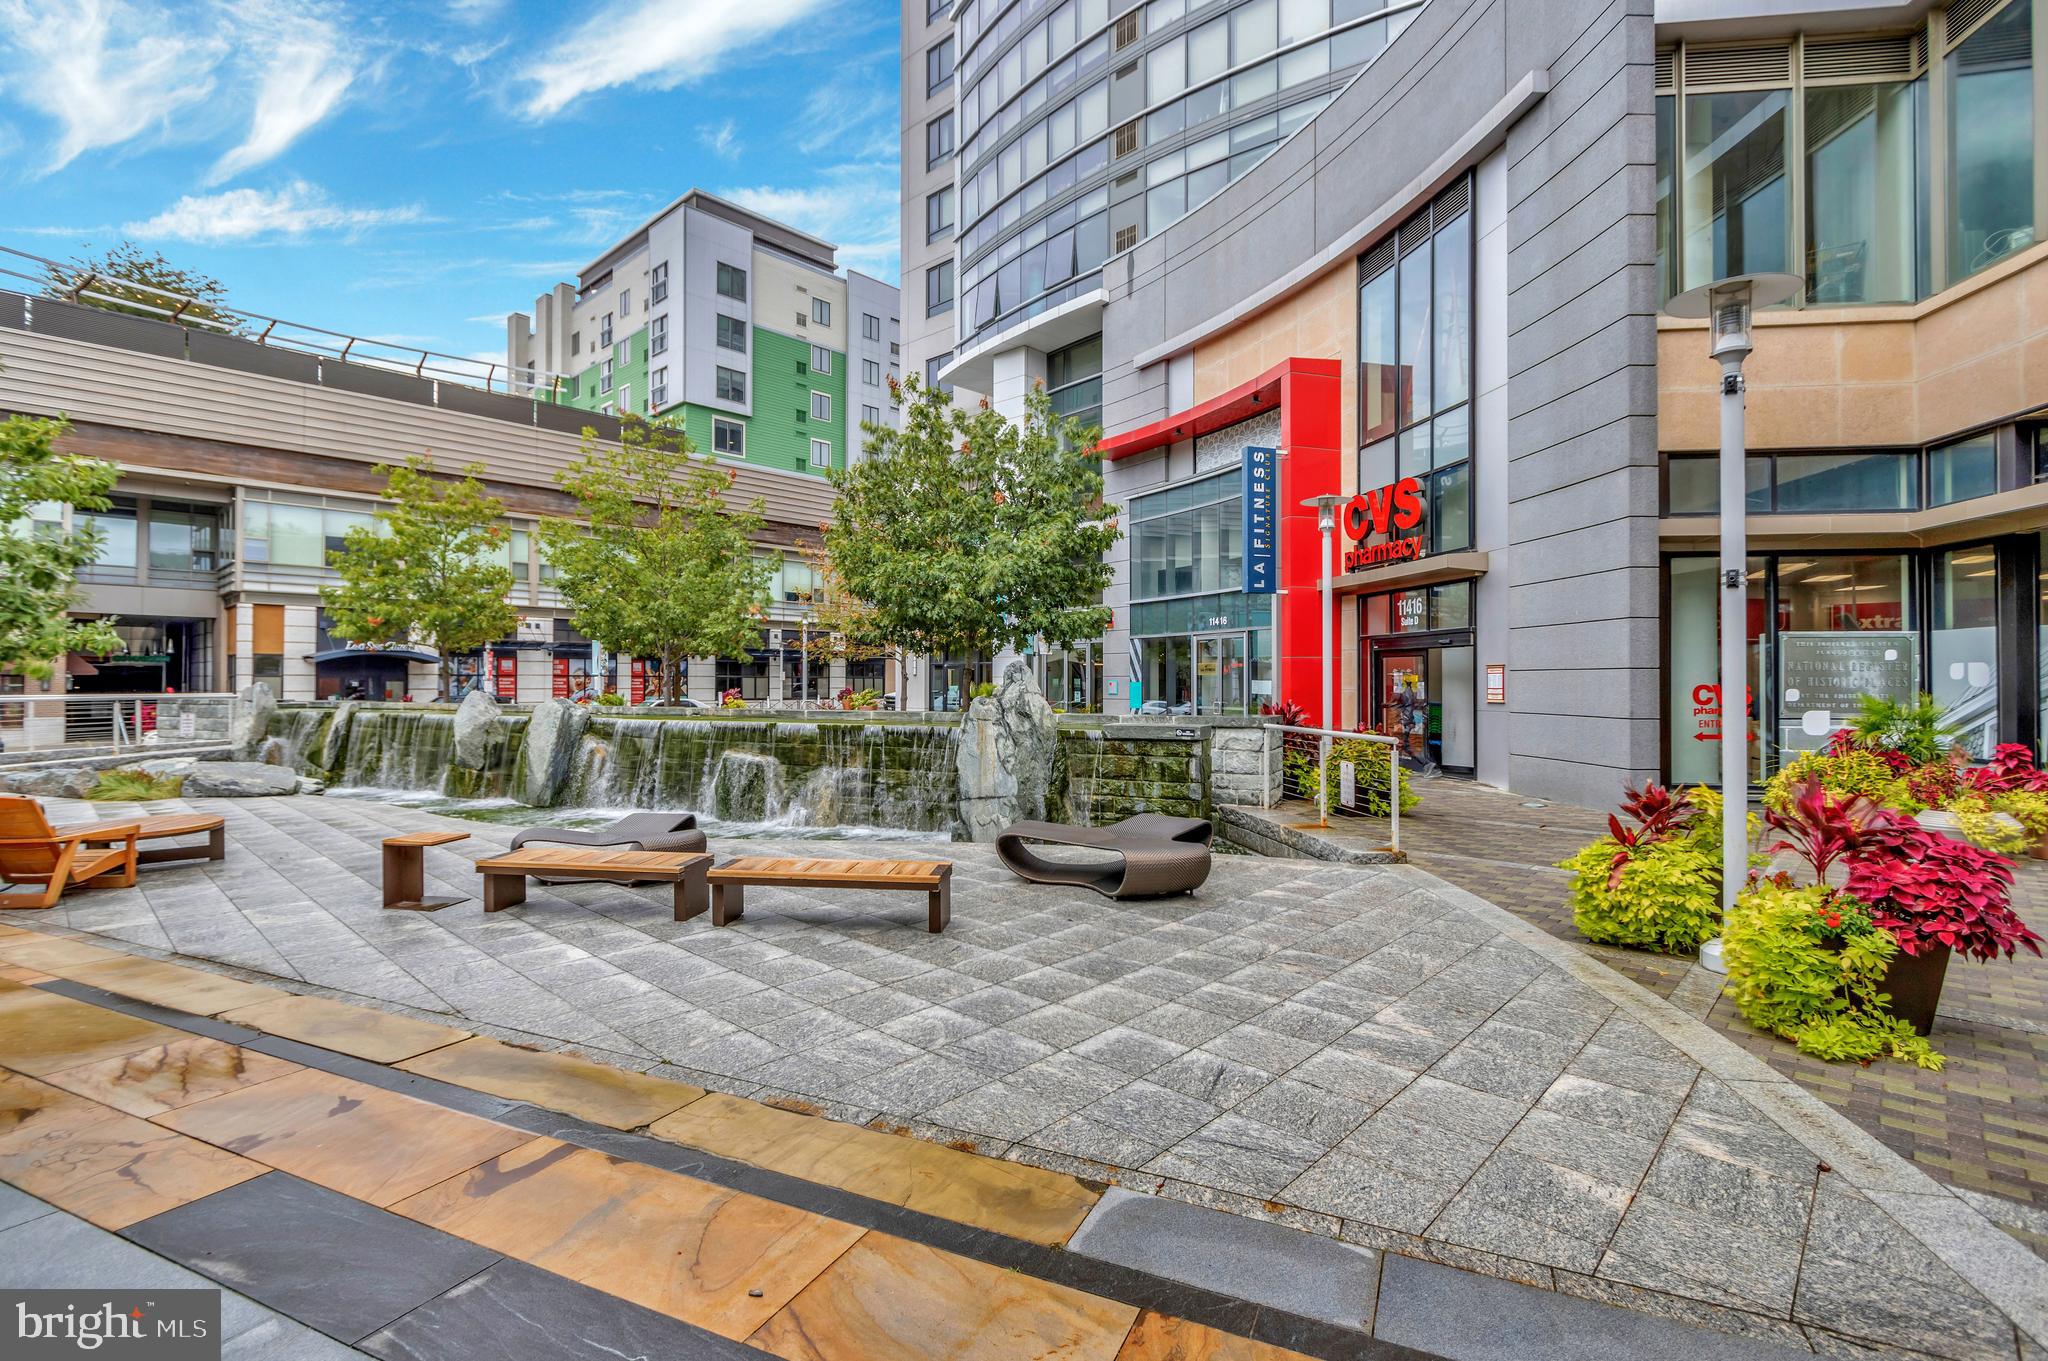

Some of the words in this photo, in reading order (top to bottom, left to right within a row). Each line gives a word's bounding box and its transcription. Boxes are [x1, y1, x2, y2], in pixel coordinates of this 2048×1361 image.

[1264, 453, 1272, 481] CLUB
[1253, 451, 1265, 549] FITNESS
[1344, 477, 1424, 541] CVS
[1264, 488, 1272, 549] SIGNATURE
[1345, 535, 1423, 573] pharmacy
[1397, 597, 1423, 616] 11416
[1209, 616, 1228, 626] 11416
[1400, 616, 1414, 626] Suite
[1414, 615, 1419, 625] D
[1787, 661, 1845, 672] NATIONAL
[1851, 661, 1909, 672] REGISTER
[1787, 677, 1801, 687] OF
[1807, 677, 1860, 688] HISTORIC
[1864, 677, 1909, 688] PLACES
